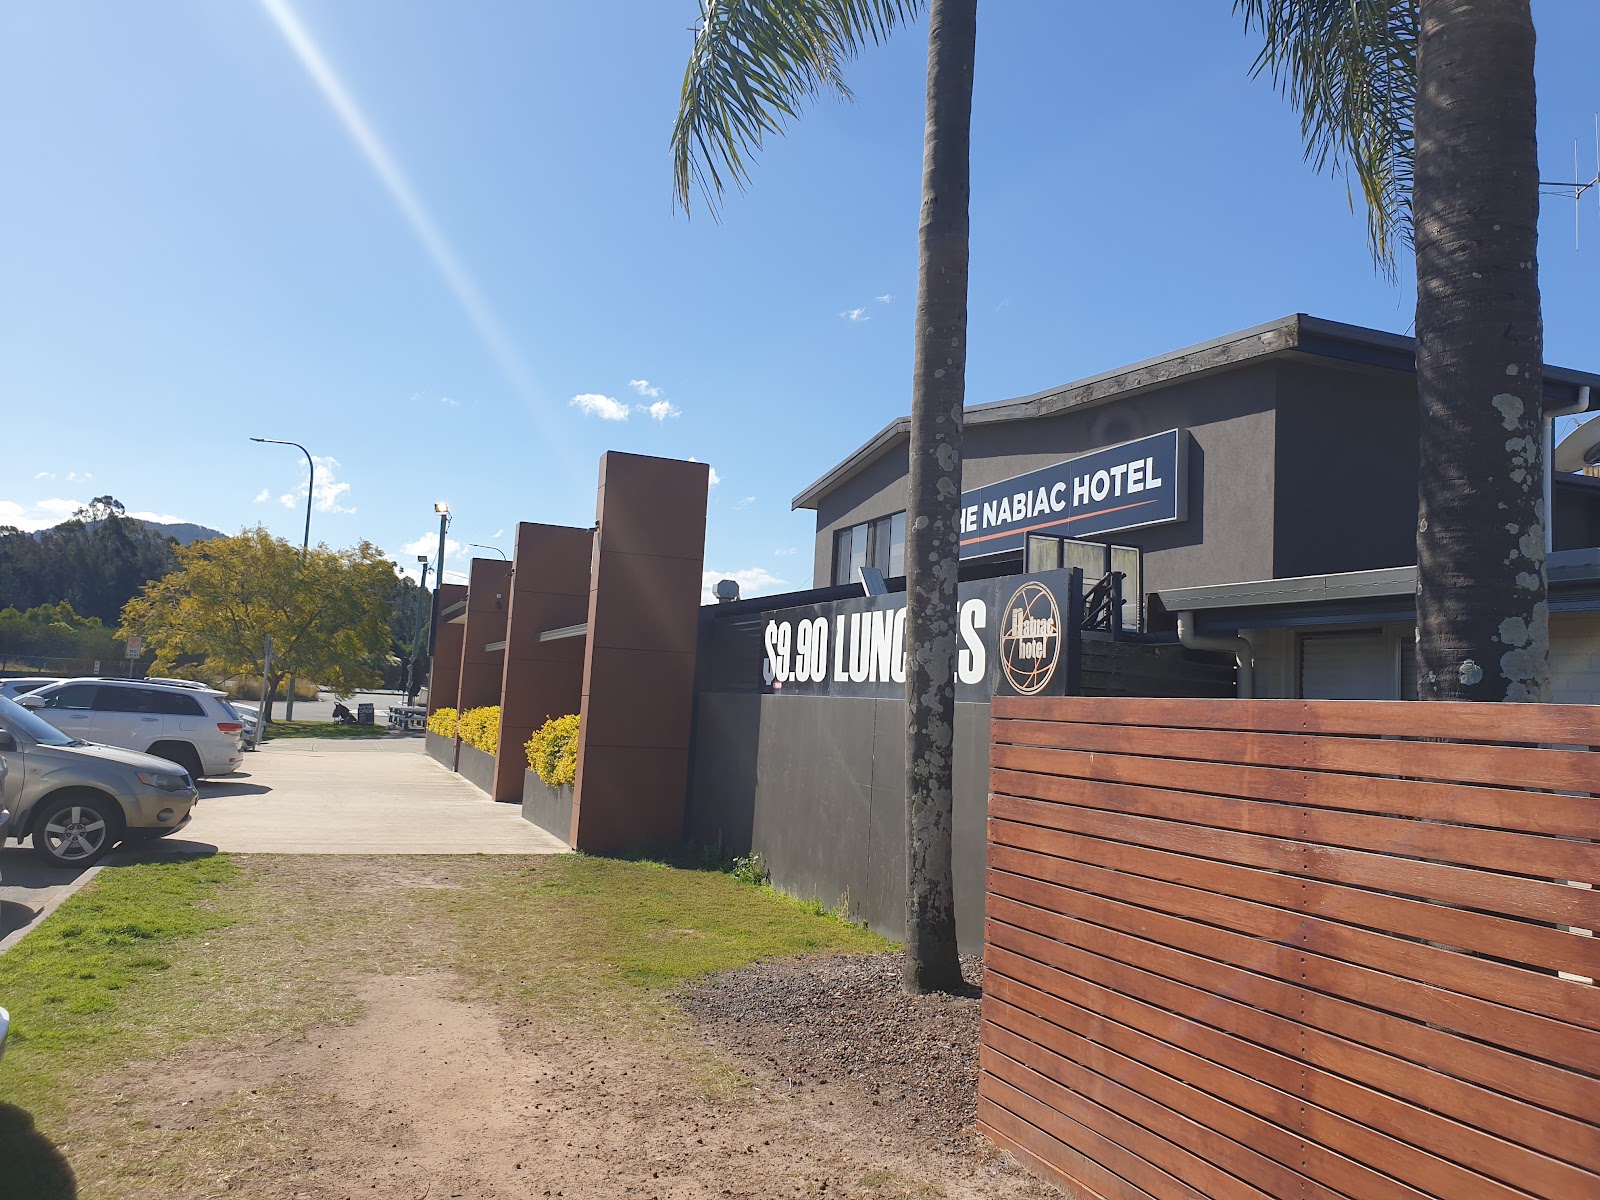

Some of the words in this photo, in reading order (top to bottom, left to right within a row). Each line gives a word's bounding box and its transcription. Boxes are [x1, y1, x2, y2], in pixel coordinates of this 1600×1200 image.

[960, 504, 978, 533] HE
[983, 481, 1066, 529] NABIAC
[1073, 456, 1162, 507] HOTEL
[763, 616, 829, 686] $9.90
[834, 598, 987, 685] LUNCS
[1018, 636, 1047, 660] hotel
